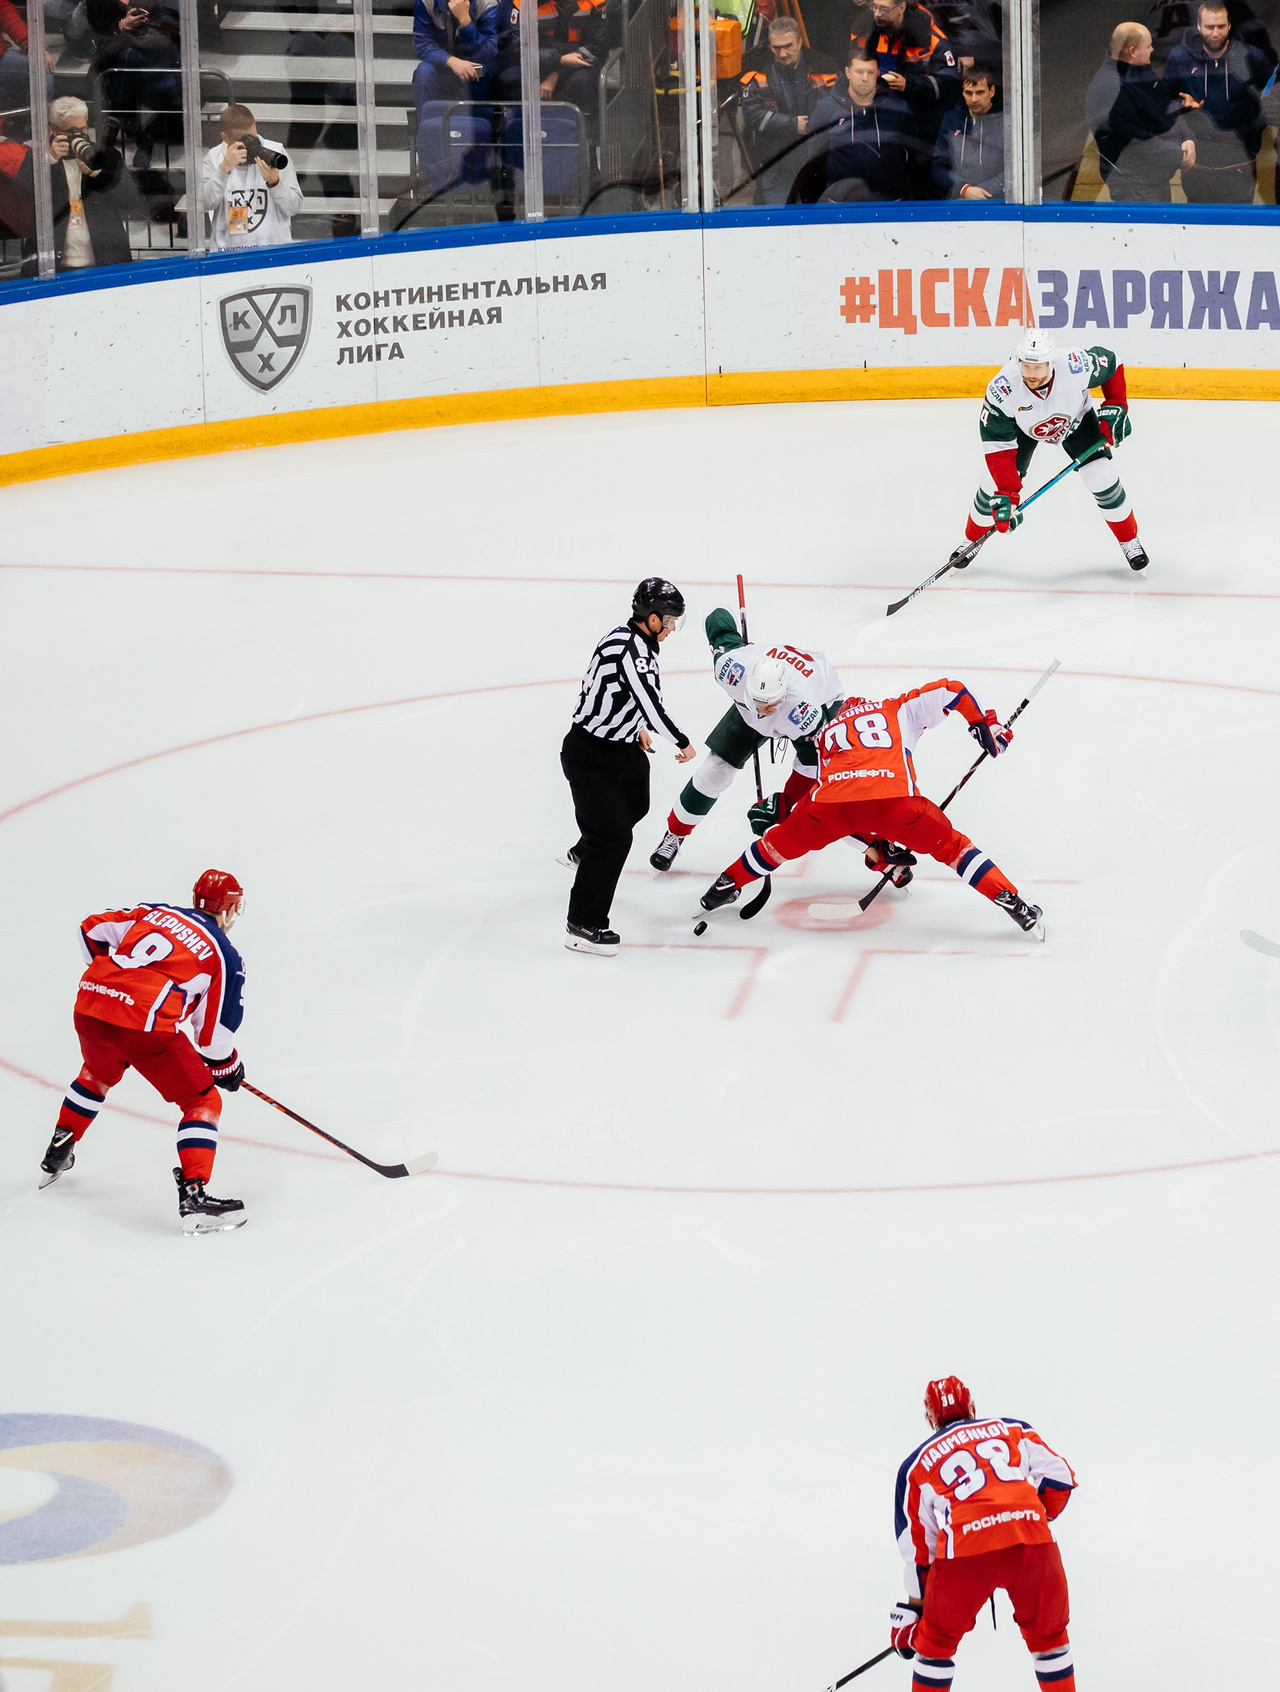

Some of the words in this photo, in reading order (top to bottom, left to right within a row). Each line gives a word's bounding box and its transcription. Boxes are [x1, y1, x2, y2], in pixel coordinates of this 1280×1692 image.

[335, 273, 608, 313] КОНТИНЕНТАЛЬНАЯ
[336, 306, 502, 339] ХОККЕЙНАЯ
[336, 342, 405, 366] ЛИГА
[635, 657, 659, 675] 84
[718, 657, 733, 681] KAZAN
[766, 648, 814, 678] POPOV
[799, 708, 819, 731] KAZAN
[828, 769, 895, 783] РОСНЕФТЬ
[200, 899, 205, 908] 9
[143, 911, 213, 961] SLEPYSHEV
[111, 932, 174, 969] 9
[921, 1422, 1010, 1472] NAUMENKOV
[962, 1510, 1040, 1535] РОСНЕФТЬ
